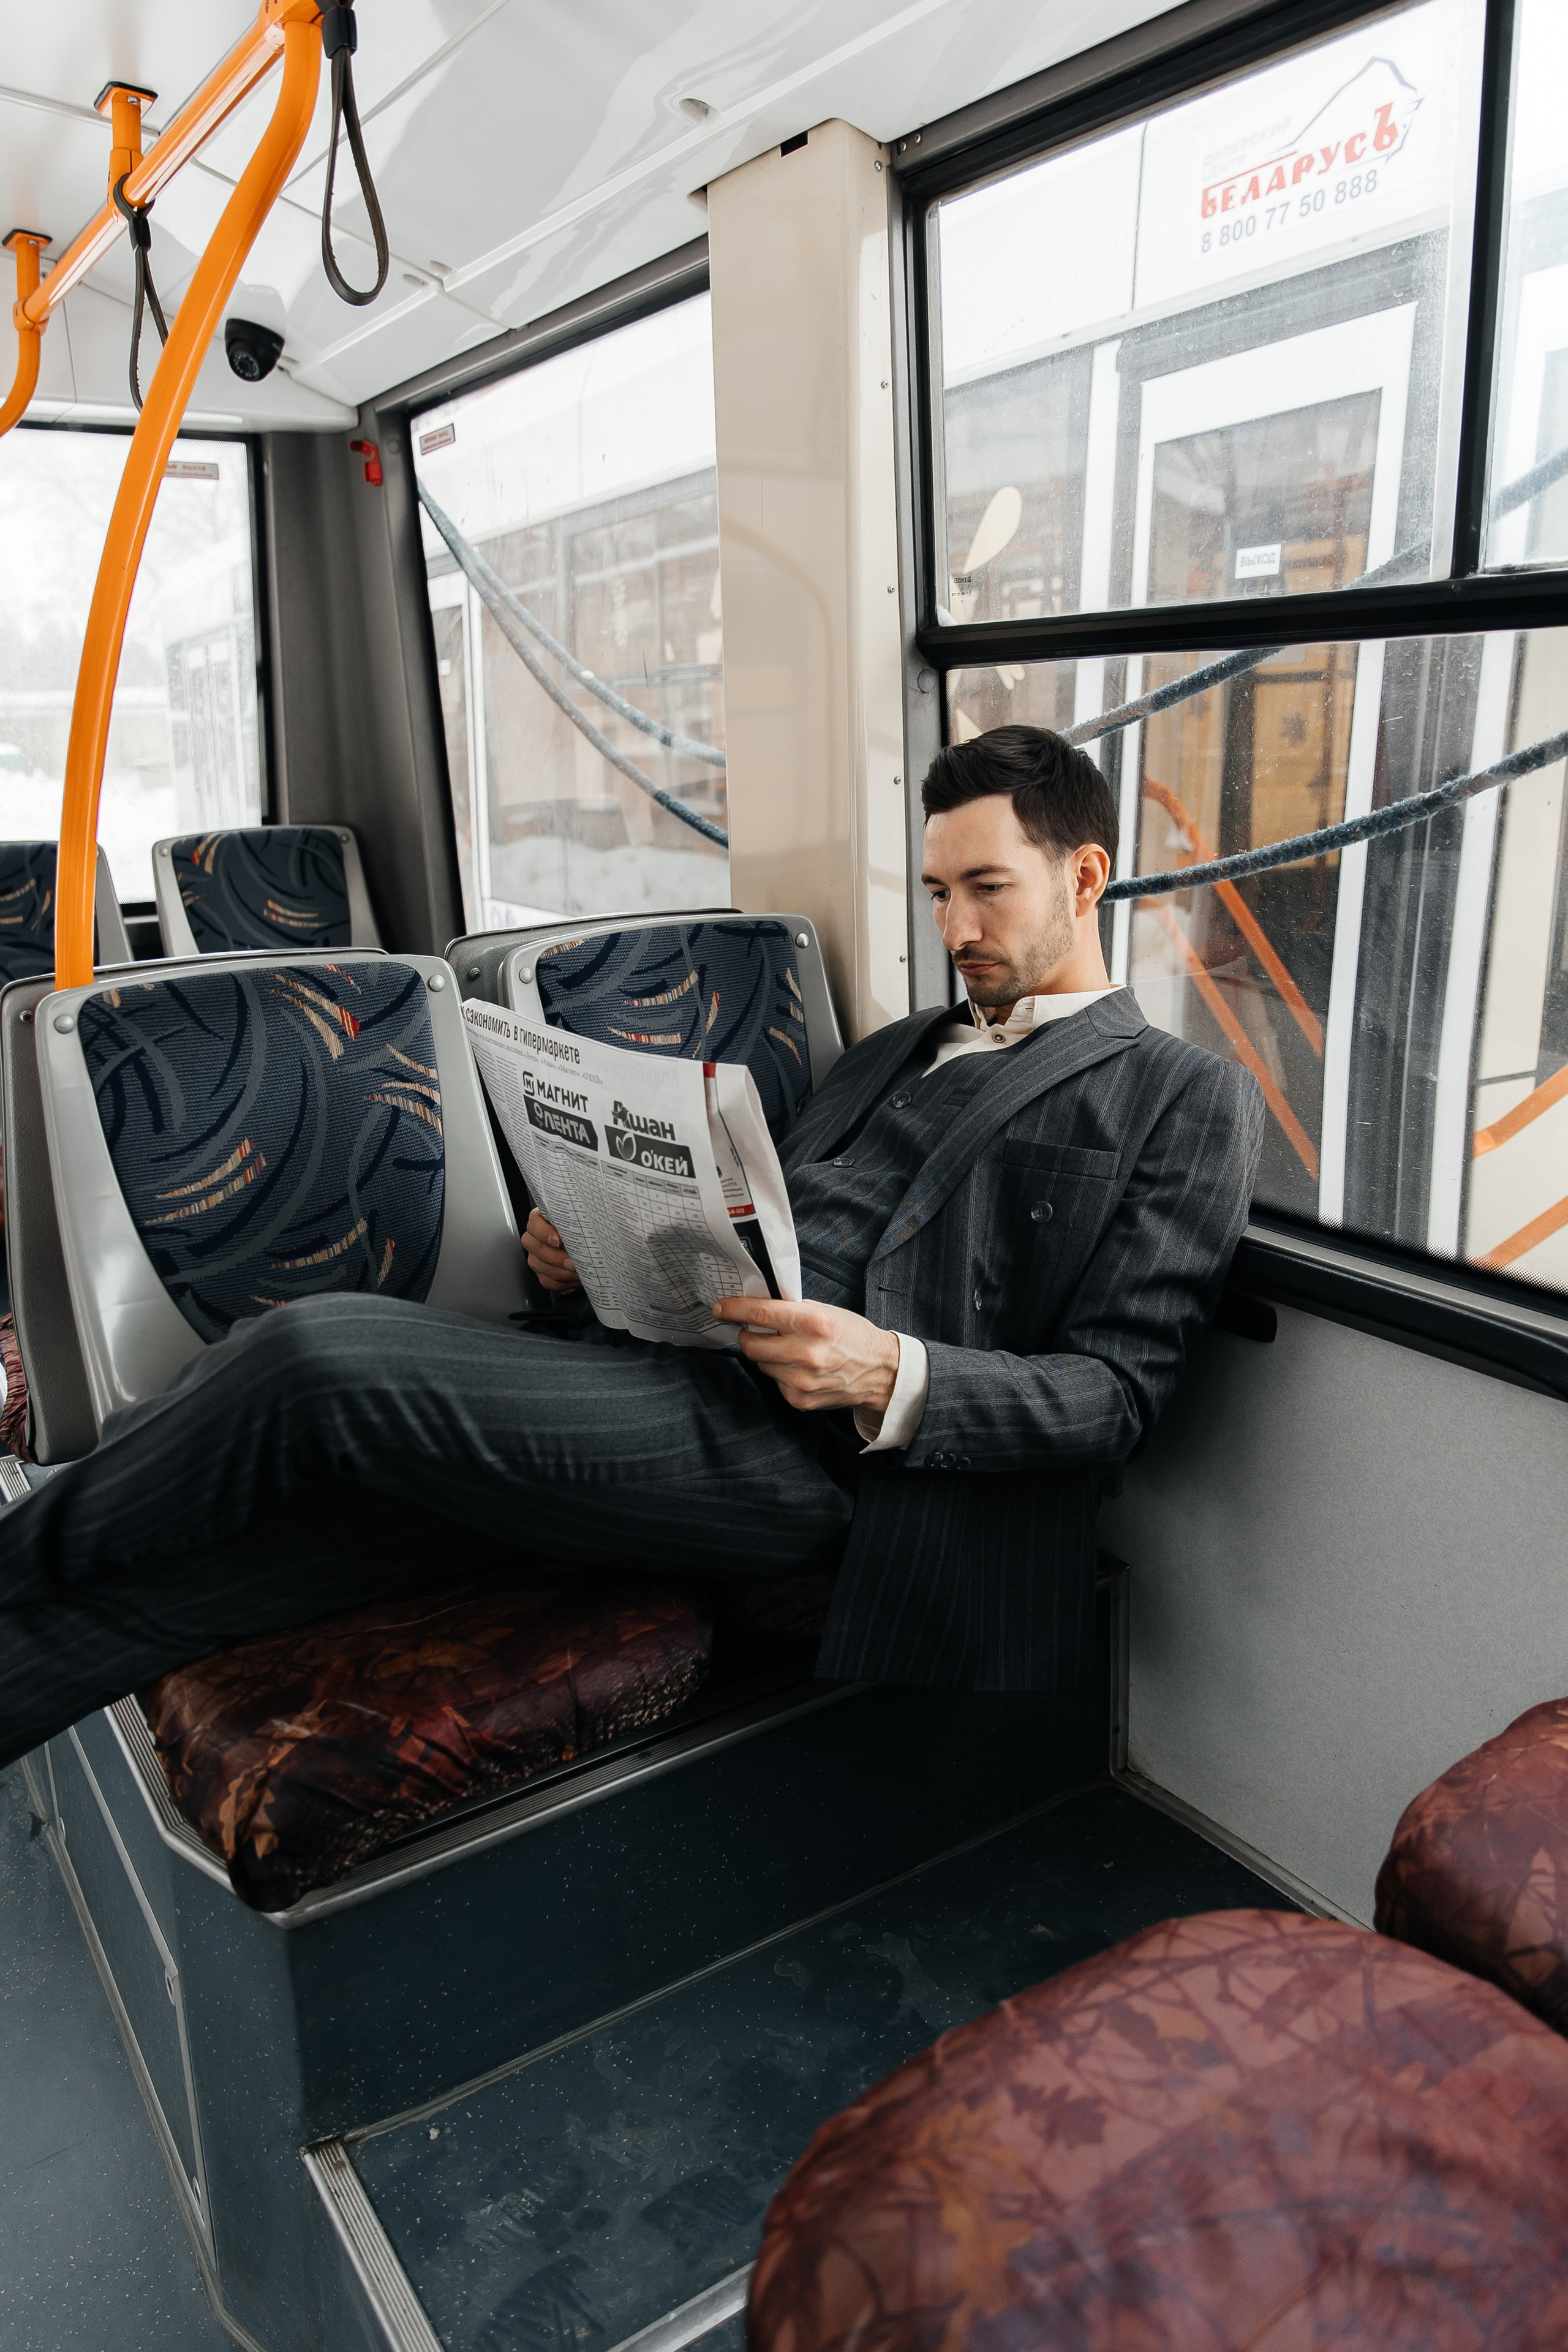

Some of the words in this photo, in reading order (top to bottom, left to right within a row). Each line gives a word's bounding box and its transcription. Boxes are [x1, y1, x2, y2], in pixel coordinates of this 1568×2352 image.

[1201, 102, 1398, 219] БЕЛАРУСЬ
[1202, 232, 1212, 253] 8
[1219, 216, 1256, 246] 800
[1266, 202, 1290, 230] 77
[1300, 189, 1325, 217] 50
[1335, 170, 1378, 203] 888
[466, 1008, 511, 1038] сэкономить
[514, 1025, 519, 1041] в
[520, 1028, 581, 1065] гипермаркете
[537, 1079, 588, 1113] МАГНИТ
[544, 1110, 591, 1144] ЛЕНТА
